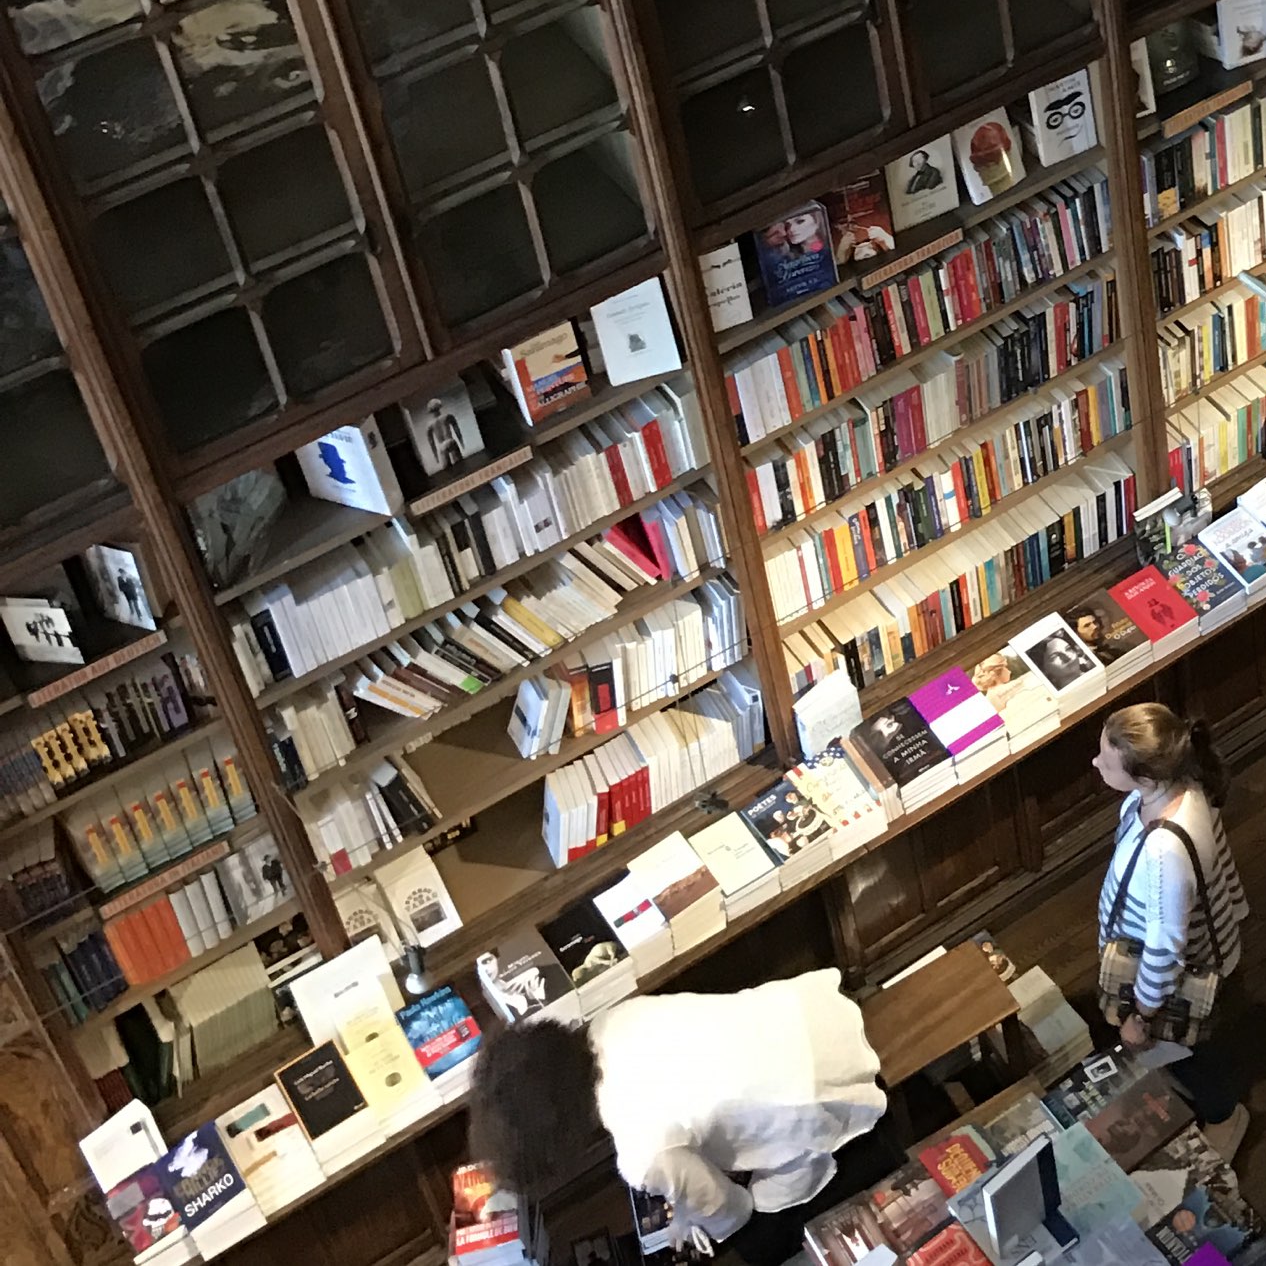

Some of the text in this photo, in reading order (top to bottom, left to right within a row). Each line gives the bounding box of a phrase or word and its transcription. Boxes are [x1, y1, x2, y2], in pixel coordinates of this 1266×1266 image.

[1185, 562, 1202, 577] DOS
[1187, 572, 1225, 599] PERDIDOS
[881, 729, 928, 760] CONHECESSEM
[894, 732, 904, 741] SE
[892, 738, 928, 763] A MINHA
[904, 746, 927, 765] IRMÃ
[182, 1171, 235, 1218] SHARKO
